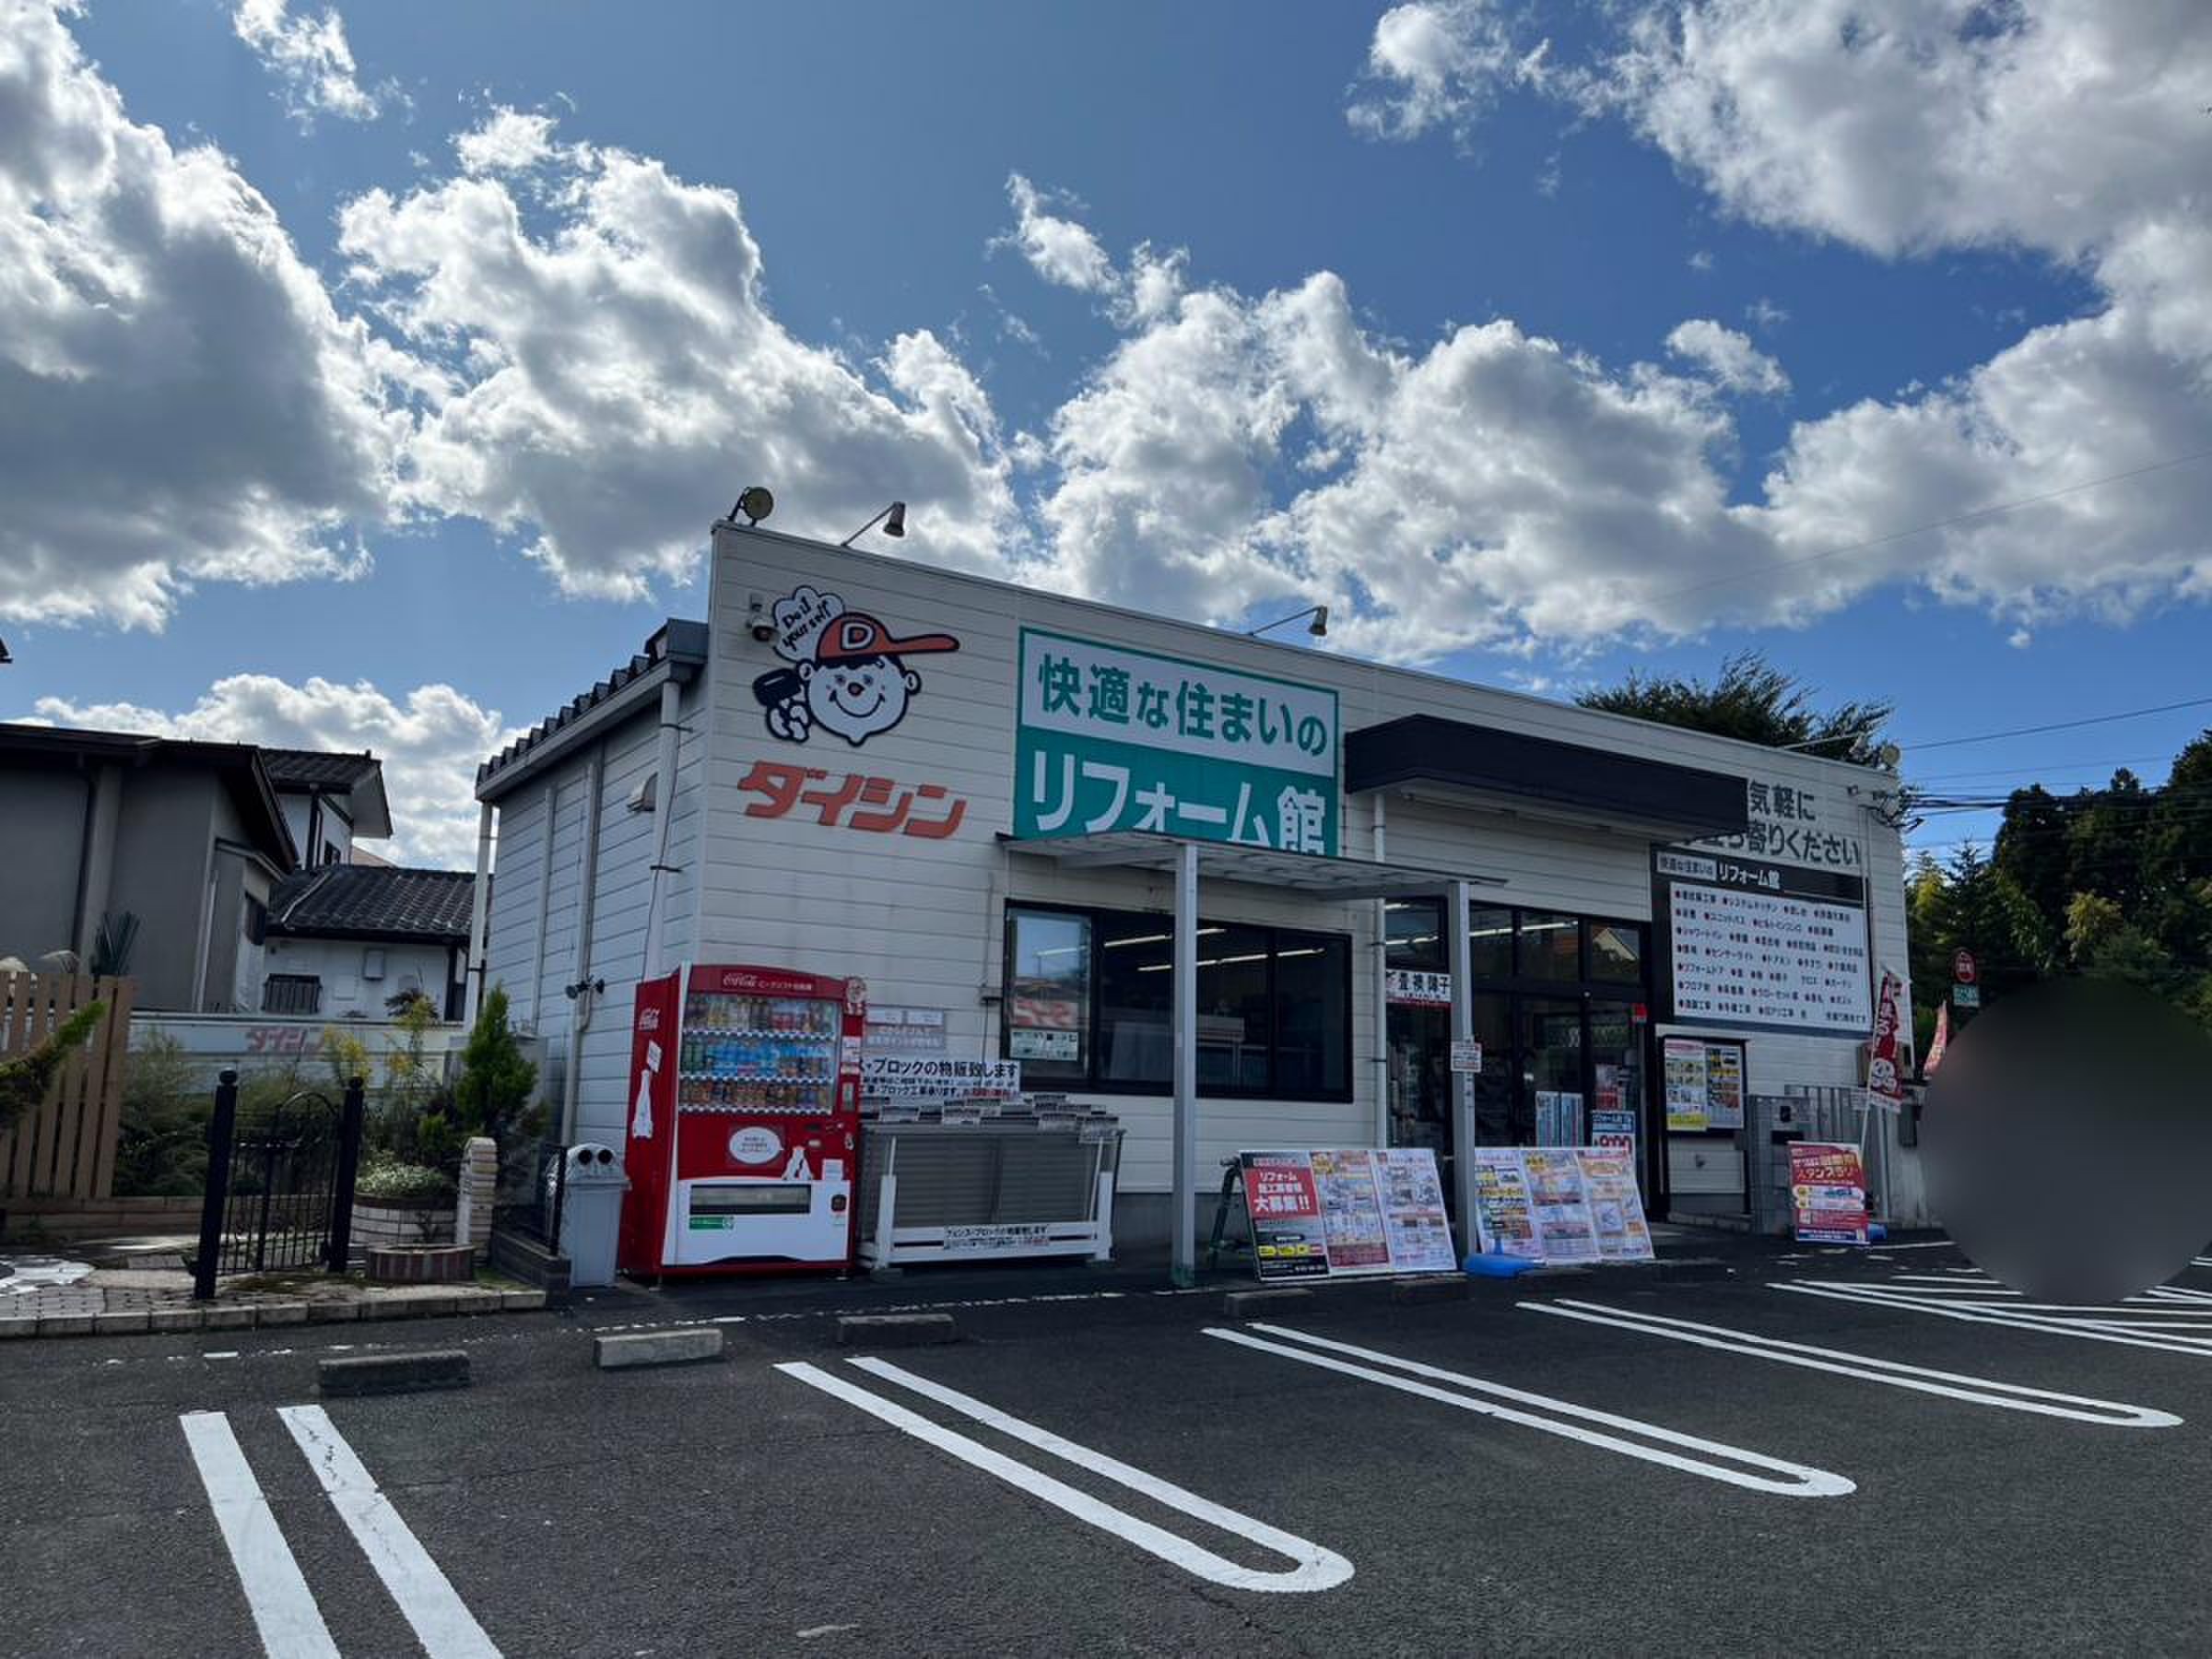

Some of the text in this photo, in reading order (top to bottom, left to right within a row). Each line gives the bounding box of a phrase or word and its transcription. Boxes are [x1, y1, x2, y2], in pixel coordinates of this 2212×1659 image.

[841, 621, 873, 651] D
[1037, 653, 1327, 757] 快適な住まいの
[737, 760, 967, 840] ダイシン
[1032, 749, 1325, 854] リフォーム館
